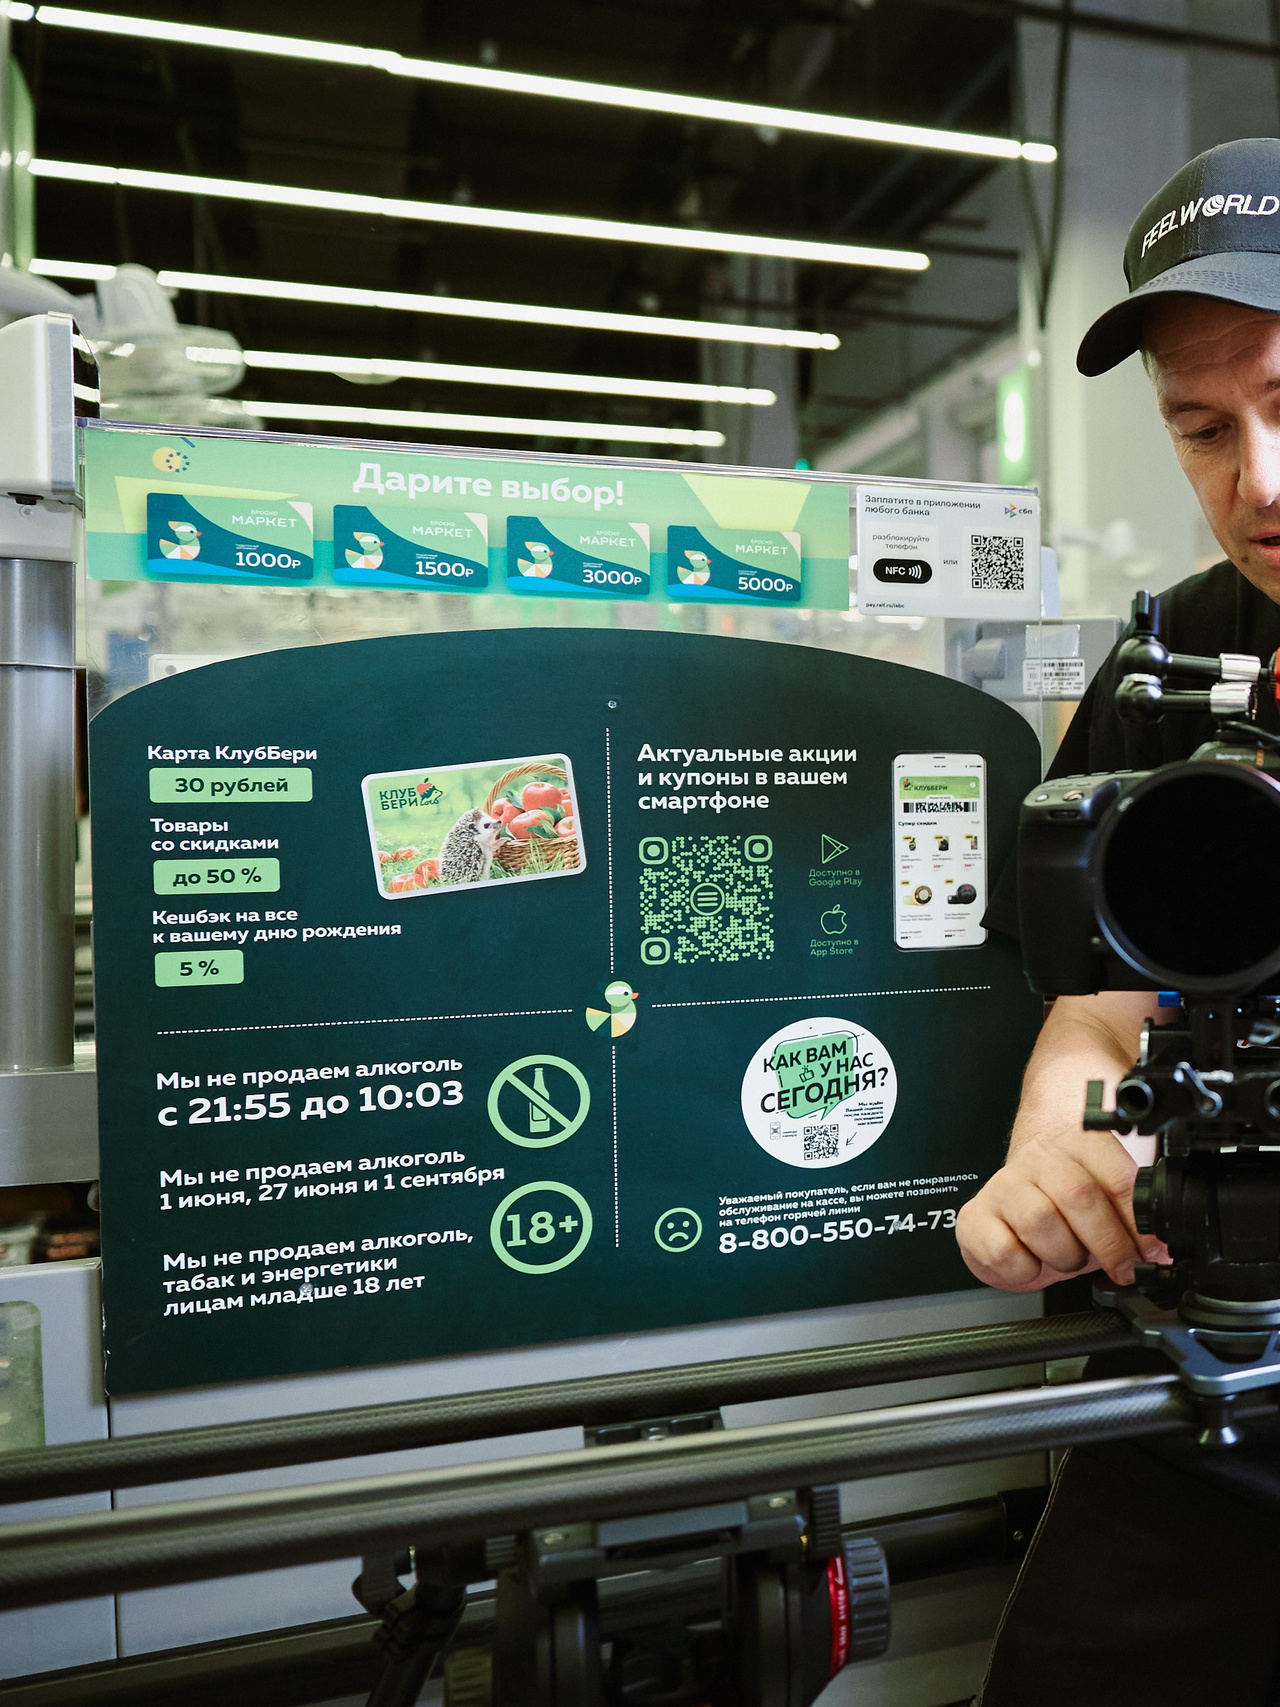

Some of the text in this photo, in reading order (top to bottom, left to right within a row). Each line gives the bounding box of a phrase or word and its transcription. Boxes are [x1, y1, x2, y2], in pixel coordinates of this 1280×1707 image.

[353, 462, 624, 511] Дарите выбор!
[864, 494, 981, 510] Заплатите в приложении
[864, 506, 930, 516] любого банка
[231, 515, 297, 528] МАРКЕТ
[412, 526, 473, 538] МАРКЕТ
[579, 535, 636, 547] МАРКЕТ
[872, 533, 930, 543] разблокируйте
[735, 544, 788, 556] МАРКЕТ
[885, 542, 918, 550] телефон
[885, 565, 906, 576] NFC
[147, 745, 318, 764] Карта КлубБери
[637, 743, 857, 767] Актуальные акции
[174, 777, 289, 797] 30 рублей
[637, 771, 848, 791] и купоны в вашем
[379, 787, 417, 800] КЛУБ
[637, 790, 770, 814] смартфоне
[381, 798, 418, 811] БЕРИ
[149, 817, 229, 836] Товары
[150, 837, 279, 853] со скидками
[172, 866, 262, 887] до 50 %
[808, 868, 853, 879] Доступно
[808, 876, 863, 889] Google Play
[152, 908, 298, 926] Кешбэк на все
[152, 924, 402, 945] к вашему дню рождения
[809, 938, 852, 949] Доступно
[810, 946, 854, 958] App Store
[179, 959, 220, 977] 5 %
[763, 1040, 847, 1073] КАК ВАМ
[820, 1052, 874, 1078] У НАС
[156, 1058, 463, 1090] Мы не продаем алкоголь
[760, 1066, 889, 1113] СЕГОДНЯ?
[157, 1080, 464, 1127] с 21:55 до 10:03
[159, 1150, 466, 1188] Мы не продаем алкоголь
[159, 1166, 506, 1211] 1 июня, 27 июня и 1 сентября
[718, 1172, 979, 1206] Уважаемый покупатель, если вам не понравилось
[718, 1184, 959, 1218] обслуживание на кассе, вы можете позвонить
[719, 1205, 861, 1228] на телефон горячей линии
[505, 1210, 579, 1248] 18+
[718, 1208, 958, 1255] 8-800-550-74-73
[163, 1227, 474, 1271] Мы не продаем алкоголь,
[163, 1256, 398, 1294] табак и энергетики
[163, 1274, 426, 1318] лицам младше 18 лет
